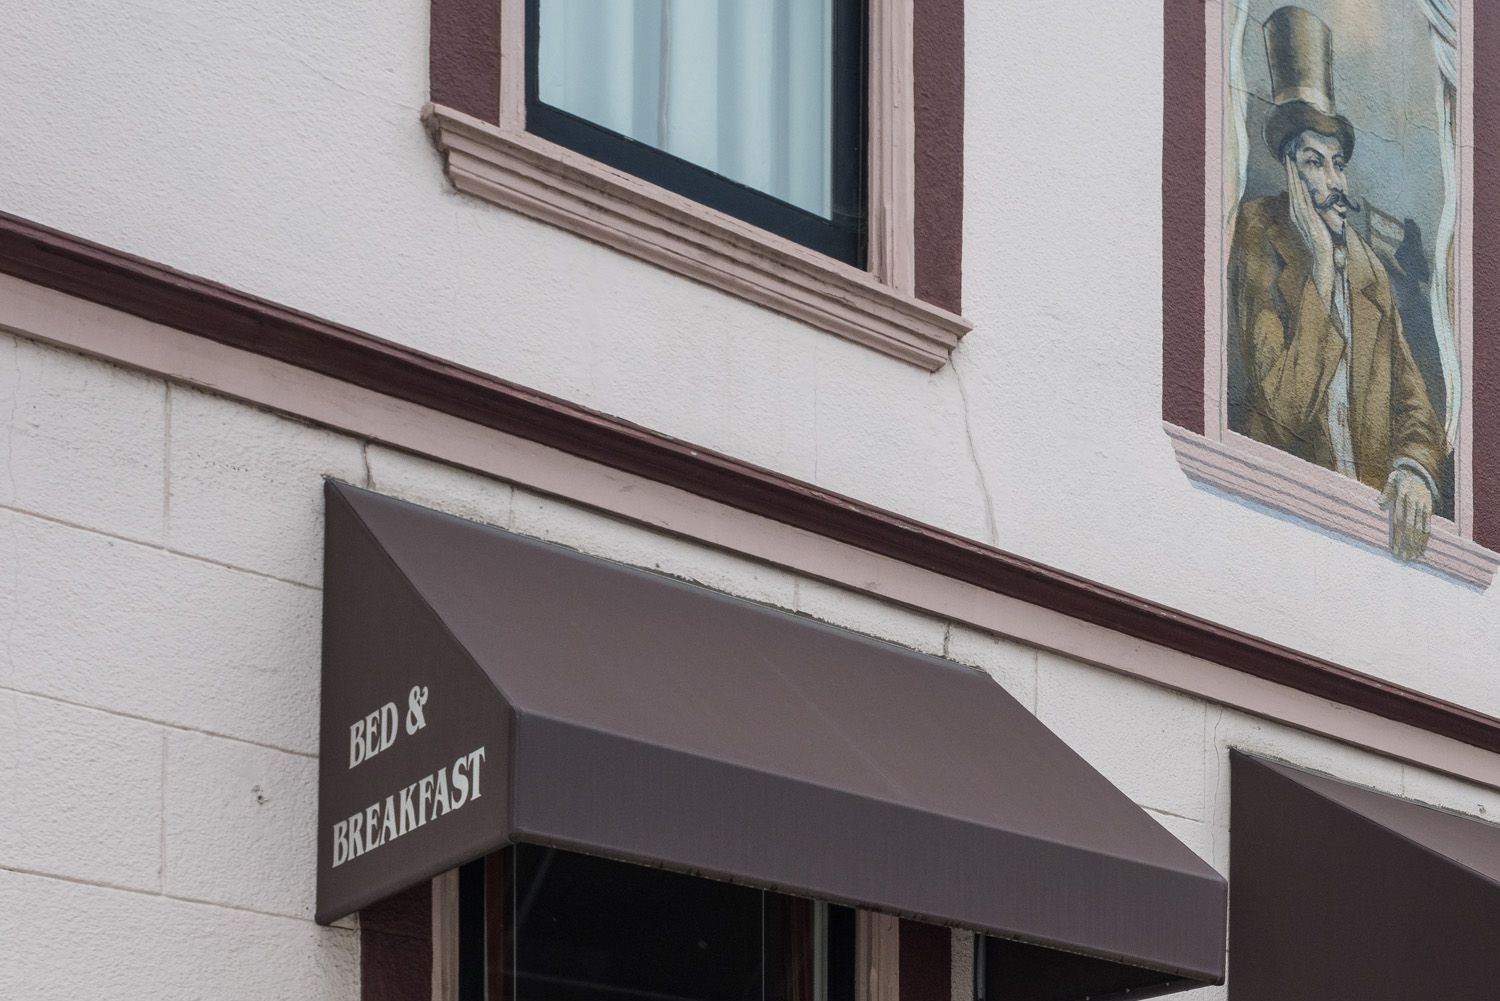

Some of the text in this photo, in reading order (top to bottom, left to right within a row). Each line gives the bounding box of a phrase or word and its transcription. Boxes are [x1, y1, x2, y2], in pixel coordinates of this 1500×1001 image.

[348, 685, 429, 770] BED &
[332, 746, 486, 868] BREAKFAST
